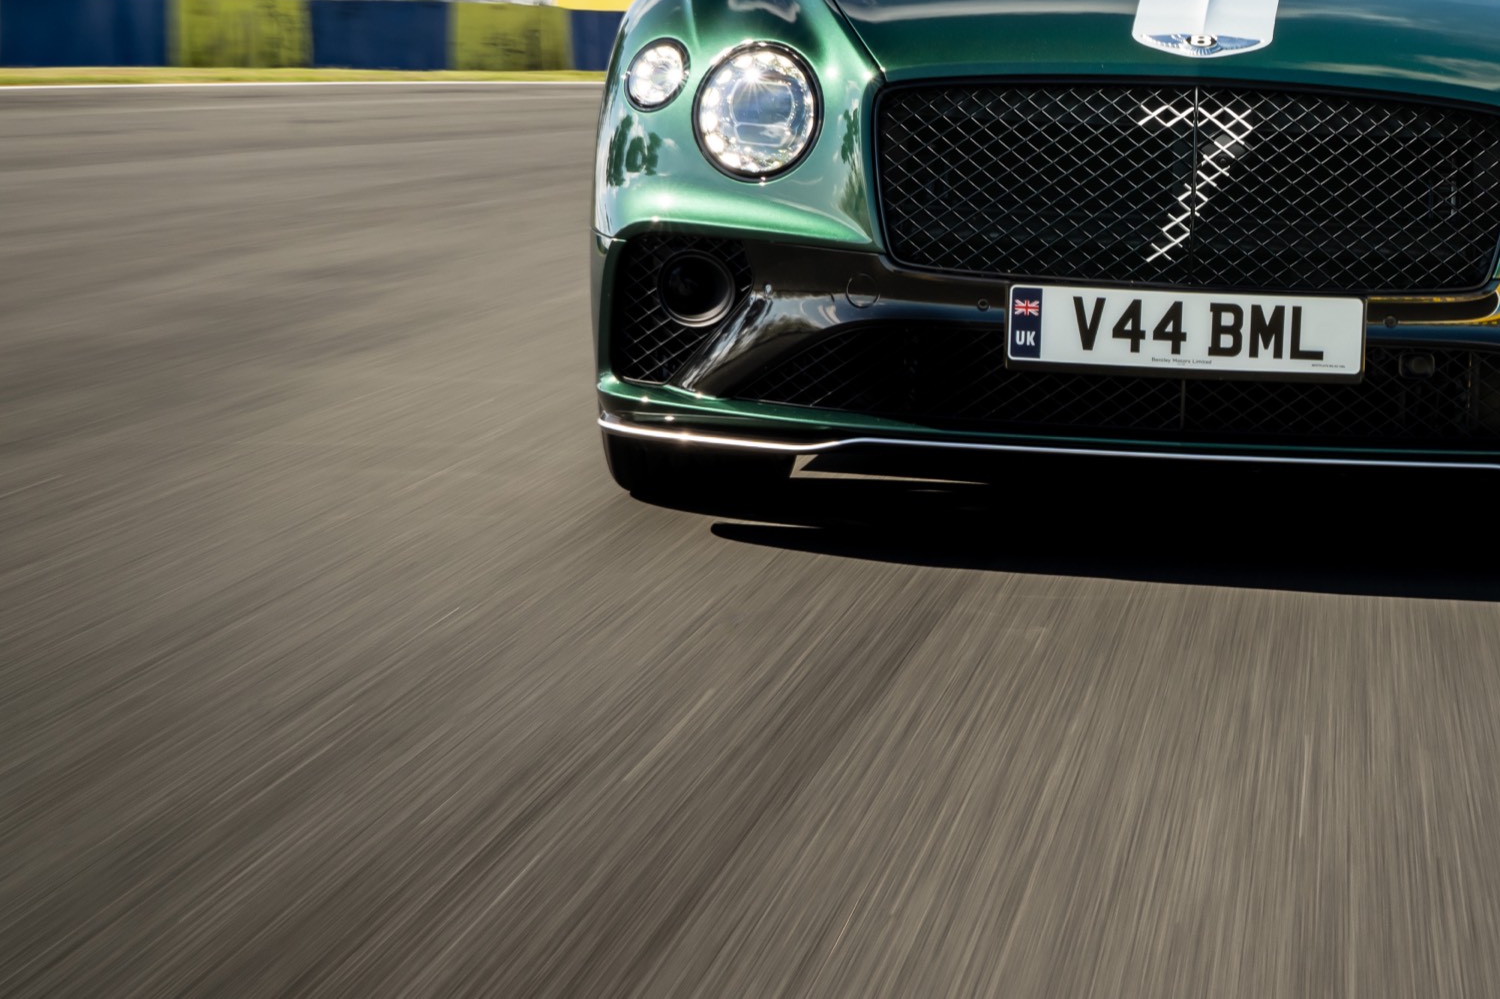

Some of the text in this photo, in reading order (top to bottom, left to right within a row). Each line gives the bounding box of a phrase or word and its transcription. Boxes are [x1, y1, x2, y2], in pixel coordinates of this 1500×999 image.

[1015, 330, 1036, 346] UK
[1072, 296, 1324, 361] V44 BML
